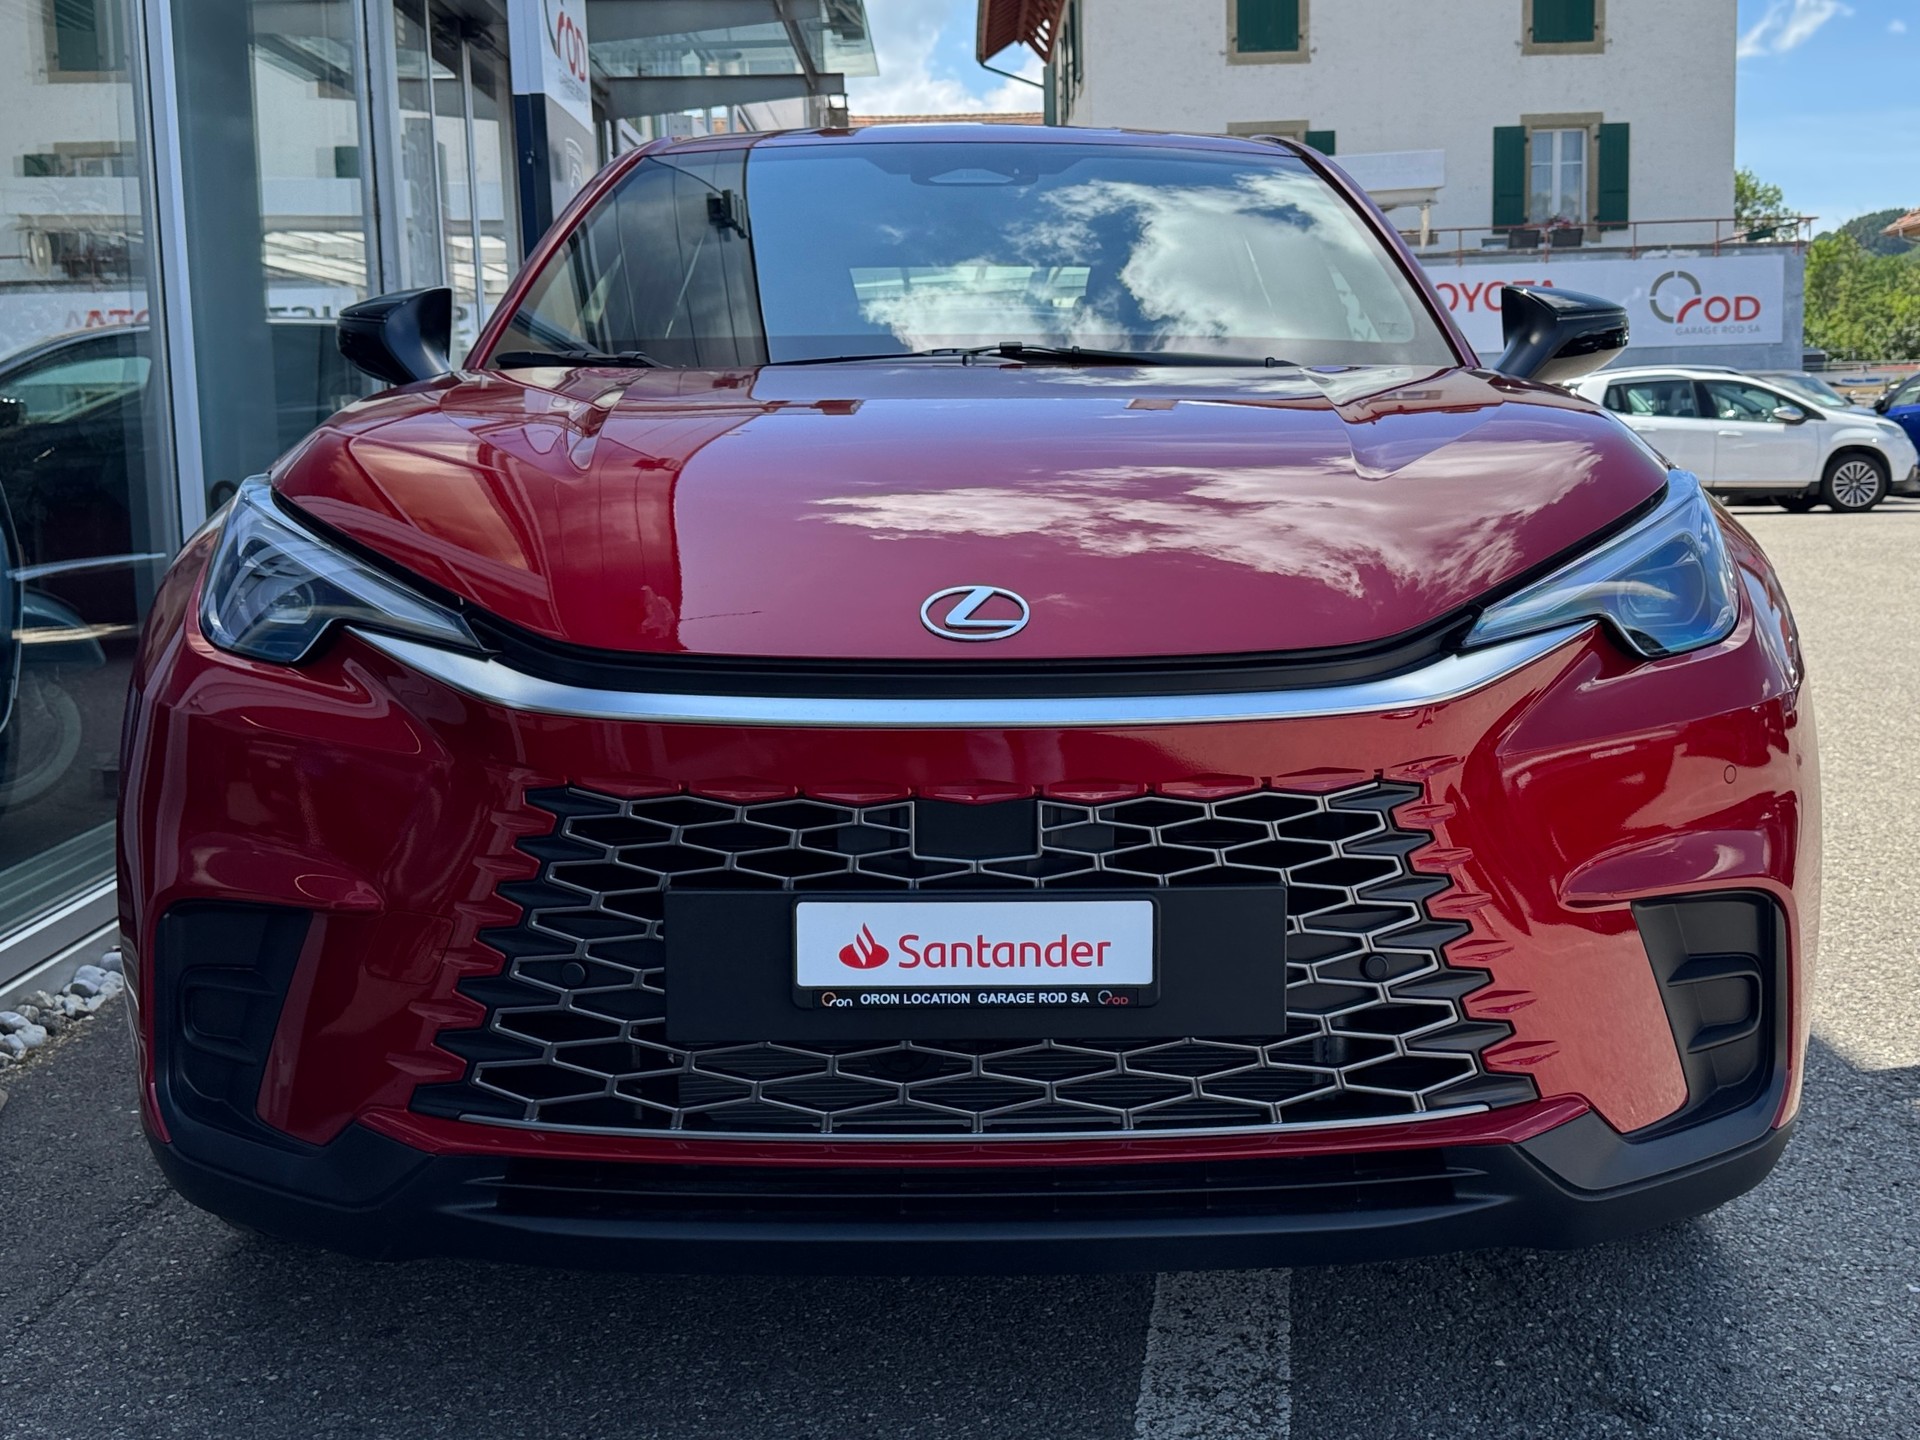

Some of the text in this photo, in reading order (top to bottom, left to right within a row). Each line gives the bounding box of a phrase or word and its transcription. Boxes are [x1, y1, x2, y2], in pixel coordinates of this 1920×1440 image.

[1675, 324, 1761, 336] GARAGE ROD SA
[898, 934, 1112, 969] Santander
[860, 993, 899, 1005] ORON
[903, 993, 971, 1005] LOCATION
[977, 992, 1035, 1004] GARAGE
[1038, 992, 1067, 1004] ROD
[1070, 992, 1090, 1004] SA
